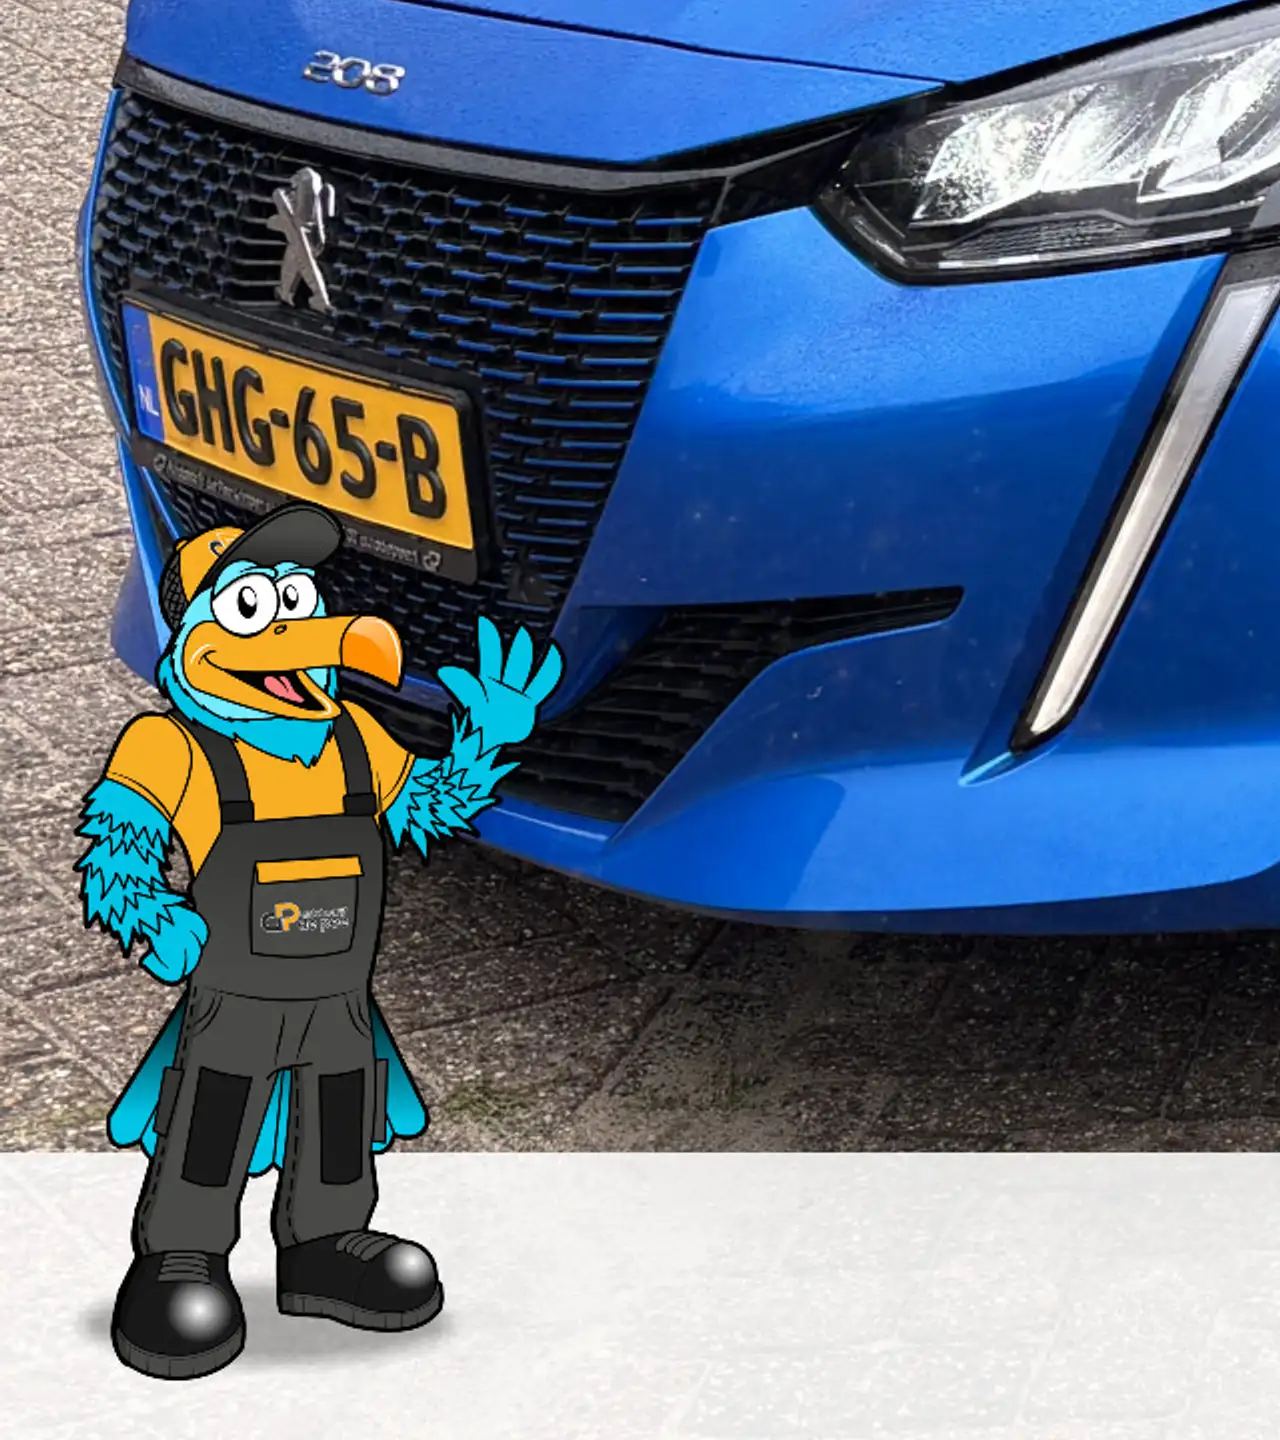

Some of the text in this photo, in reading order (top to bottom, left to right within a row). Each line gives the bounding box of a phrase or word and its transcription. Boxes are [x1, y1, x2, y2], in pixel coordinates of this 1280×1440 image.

[303, 49, 406, 95] 208
[138, 382, 160, 418] NL
[160, 337, 448, 521] GHG-65-B
